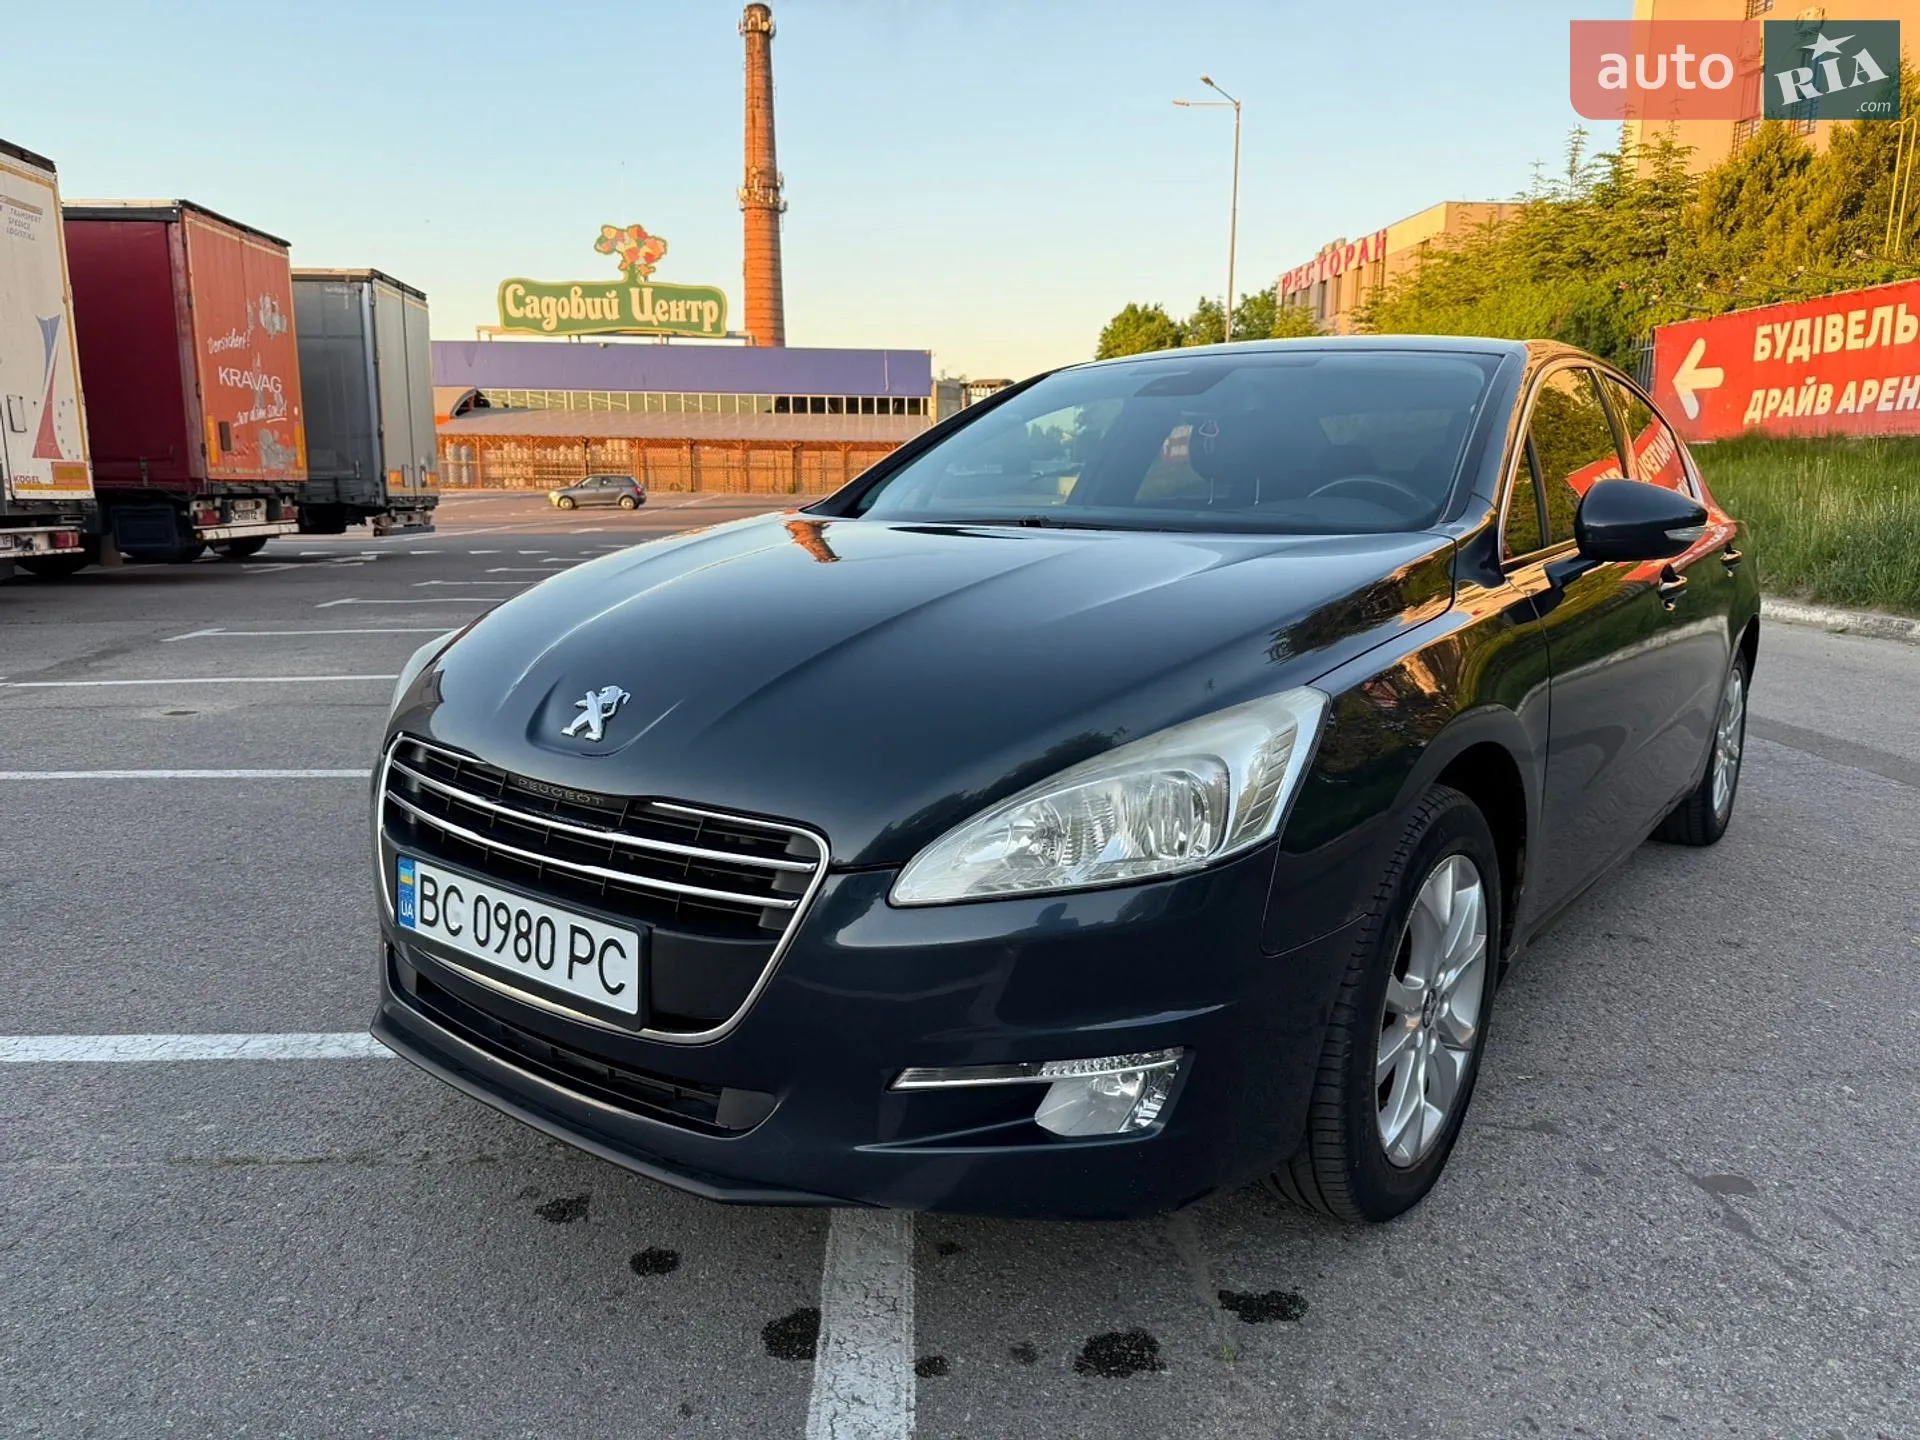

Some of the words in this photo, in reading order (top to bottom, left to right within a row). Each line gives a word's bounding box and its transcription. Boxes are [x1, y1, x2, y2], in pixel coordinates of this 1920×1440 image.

[1282, 228, 1387, 296] РЕСТОРАН
[505, 284, 620, 331] Садовий
[629, 287, 719, 332] Центр
[218, 366, 282, 393] KRAVAG
[1743, 376, 1834, 425] ДРАЙВ
[1835, 374, 1920, 415] АРЕН
[518, 778, 604, 805] PEUGEOT
[400, 901, 415, 920] UA
[419, 873, 465, 937] BC
[473, 894, 556, 971] 0980
[567, 923, 627, 996] PC
